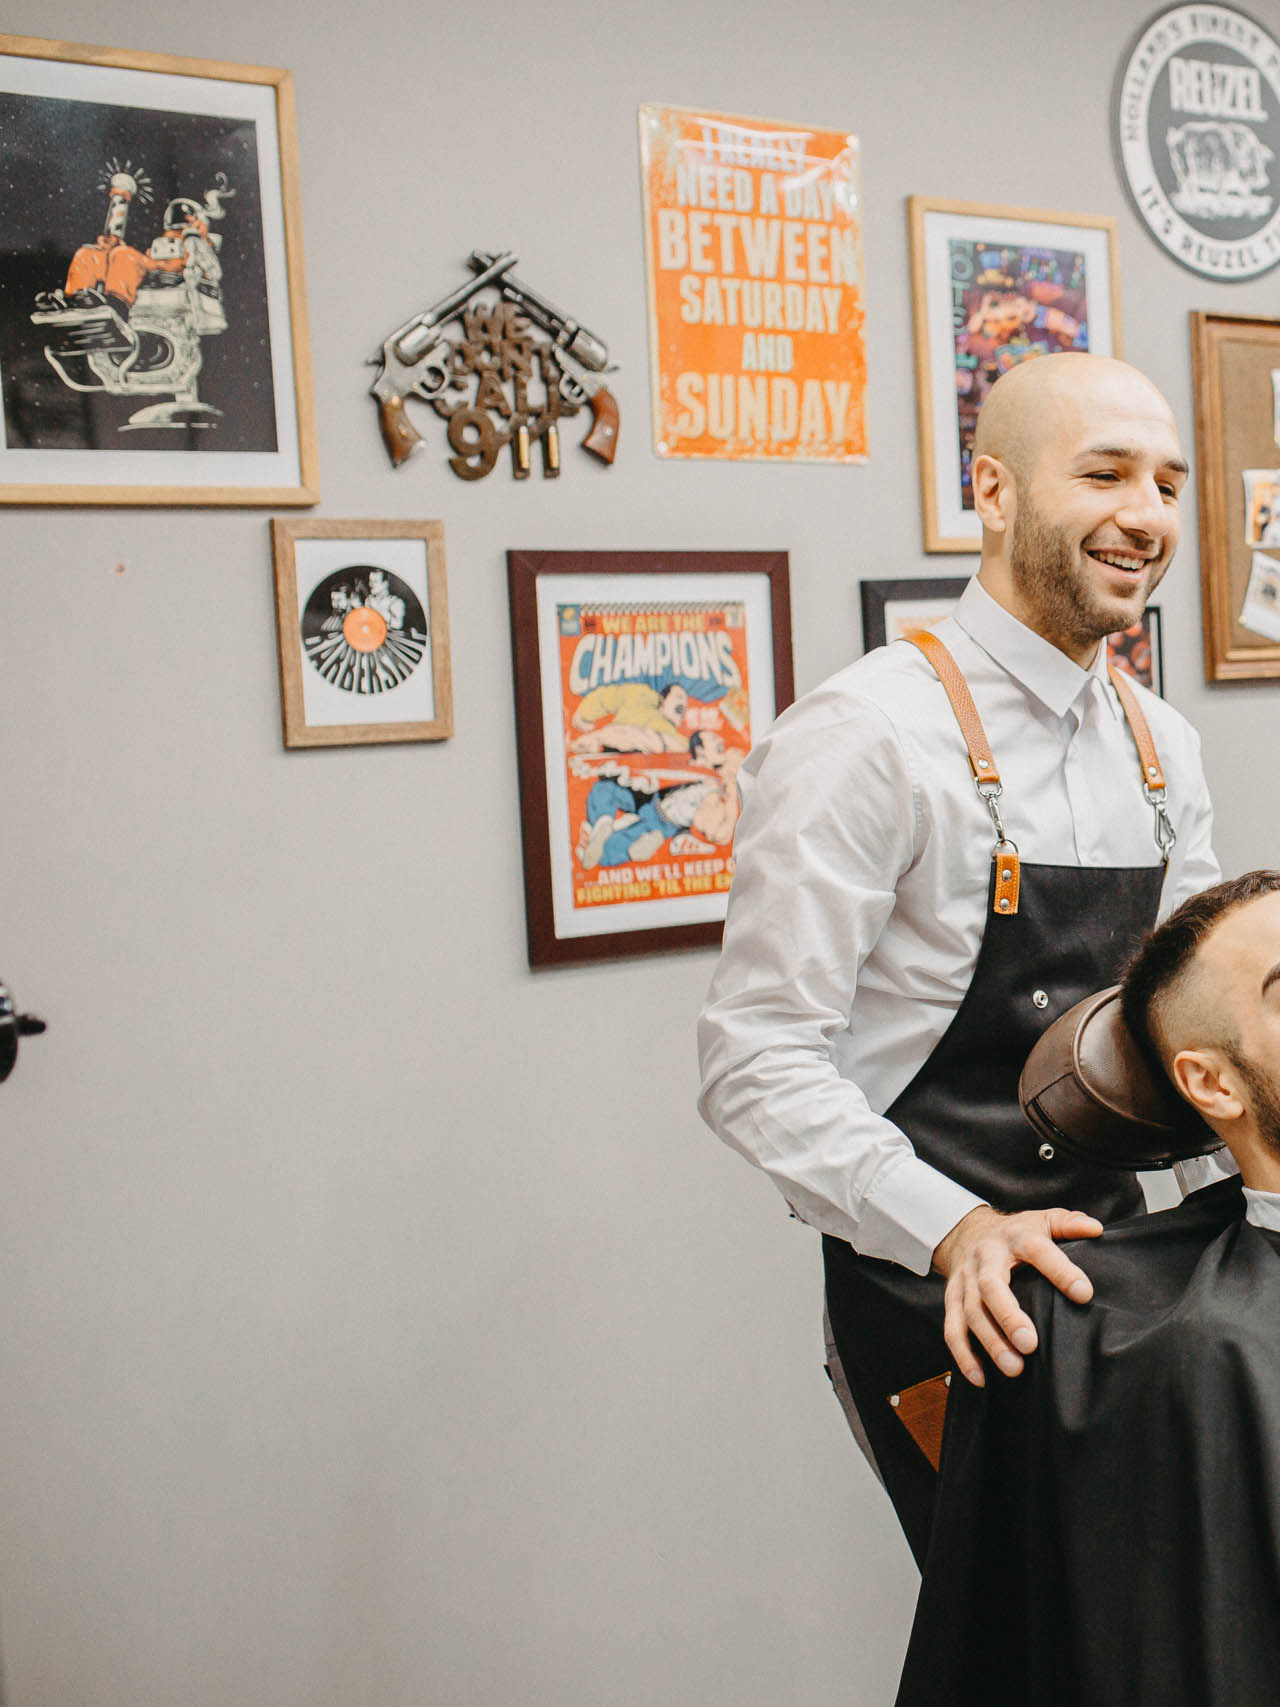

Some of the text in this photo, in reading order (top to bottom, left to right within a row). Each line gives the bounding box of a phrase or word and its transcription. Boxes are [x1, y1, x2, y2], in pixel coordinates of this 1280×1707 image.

[676, 162, 836, 222] NEED A DAY
[658, 207, 862, 286] BETWEEN
[680, 274, 843, 335] SATURDAY
[741, 332, 795, 374] AND
[675, 371, 851, 444] SUNDAY
[446, 402, 561, 481] 911
[569, 629, 743, 696] CHAMPIONS
